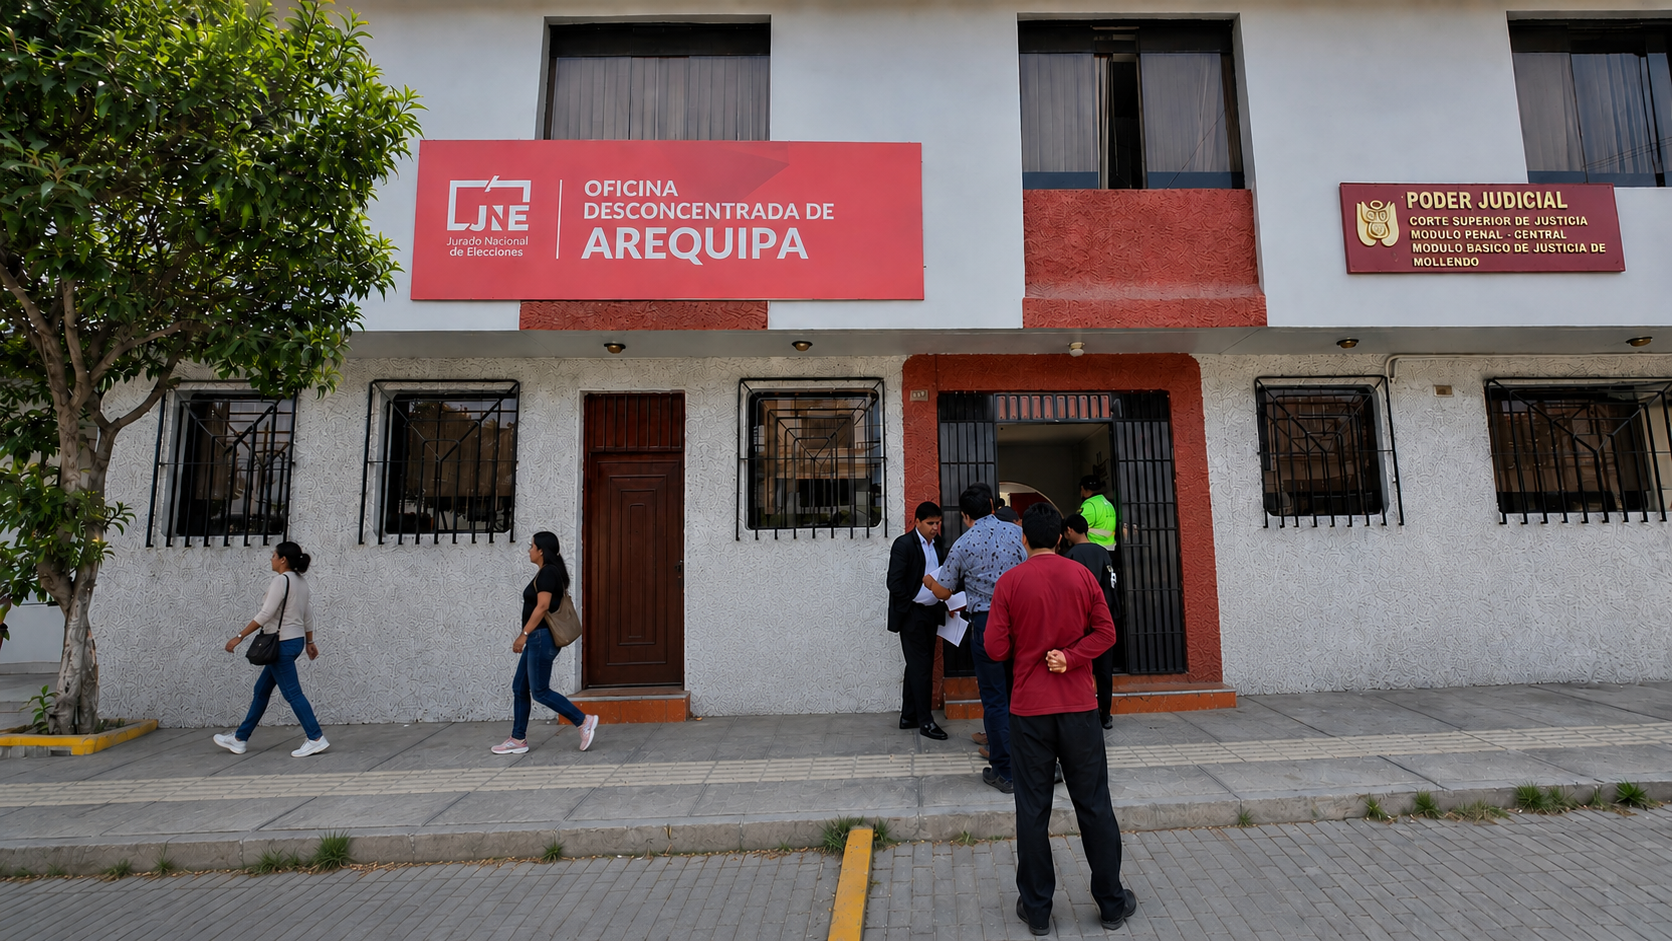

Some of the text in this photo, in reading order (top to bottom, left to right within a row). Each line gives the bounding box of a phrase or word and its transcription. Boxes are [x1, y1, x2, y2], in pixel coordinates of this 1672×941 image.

[584, 180, 679, 197] OFICINA
[1406, 191, 1568, 209] PODER JUDICIAL
[583, 202, 835, 220] DESCONCENTRADA DE
[468, 205, 530, 232] JNE
[1409, 216, 1588, 226] CORTE SUPERIOR DE JUSTICIA
[1411, 229, 1462, 240] MODULO
[1464, 229, 1504, 240] PENAL
[1514, 229, 1568, 240] CENTRAL
[446, 236, 529, 246] Jurado Nacional
[580, 226, 809, 266] AREQUIPA
[449, 247, 523, 257] de Elecciones
[1412, 243, 1606, 253] MODULO BASICO DE JUSTICIA DE
[1413, 257, 1480, 267] MOLLENDO
